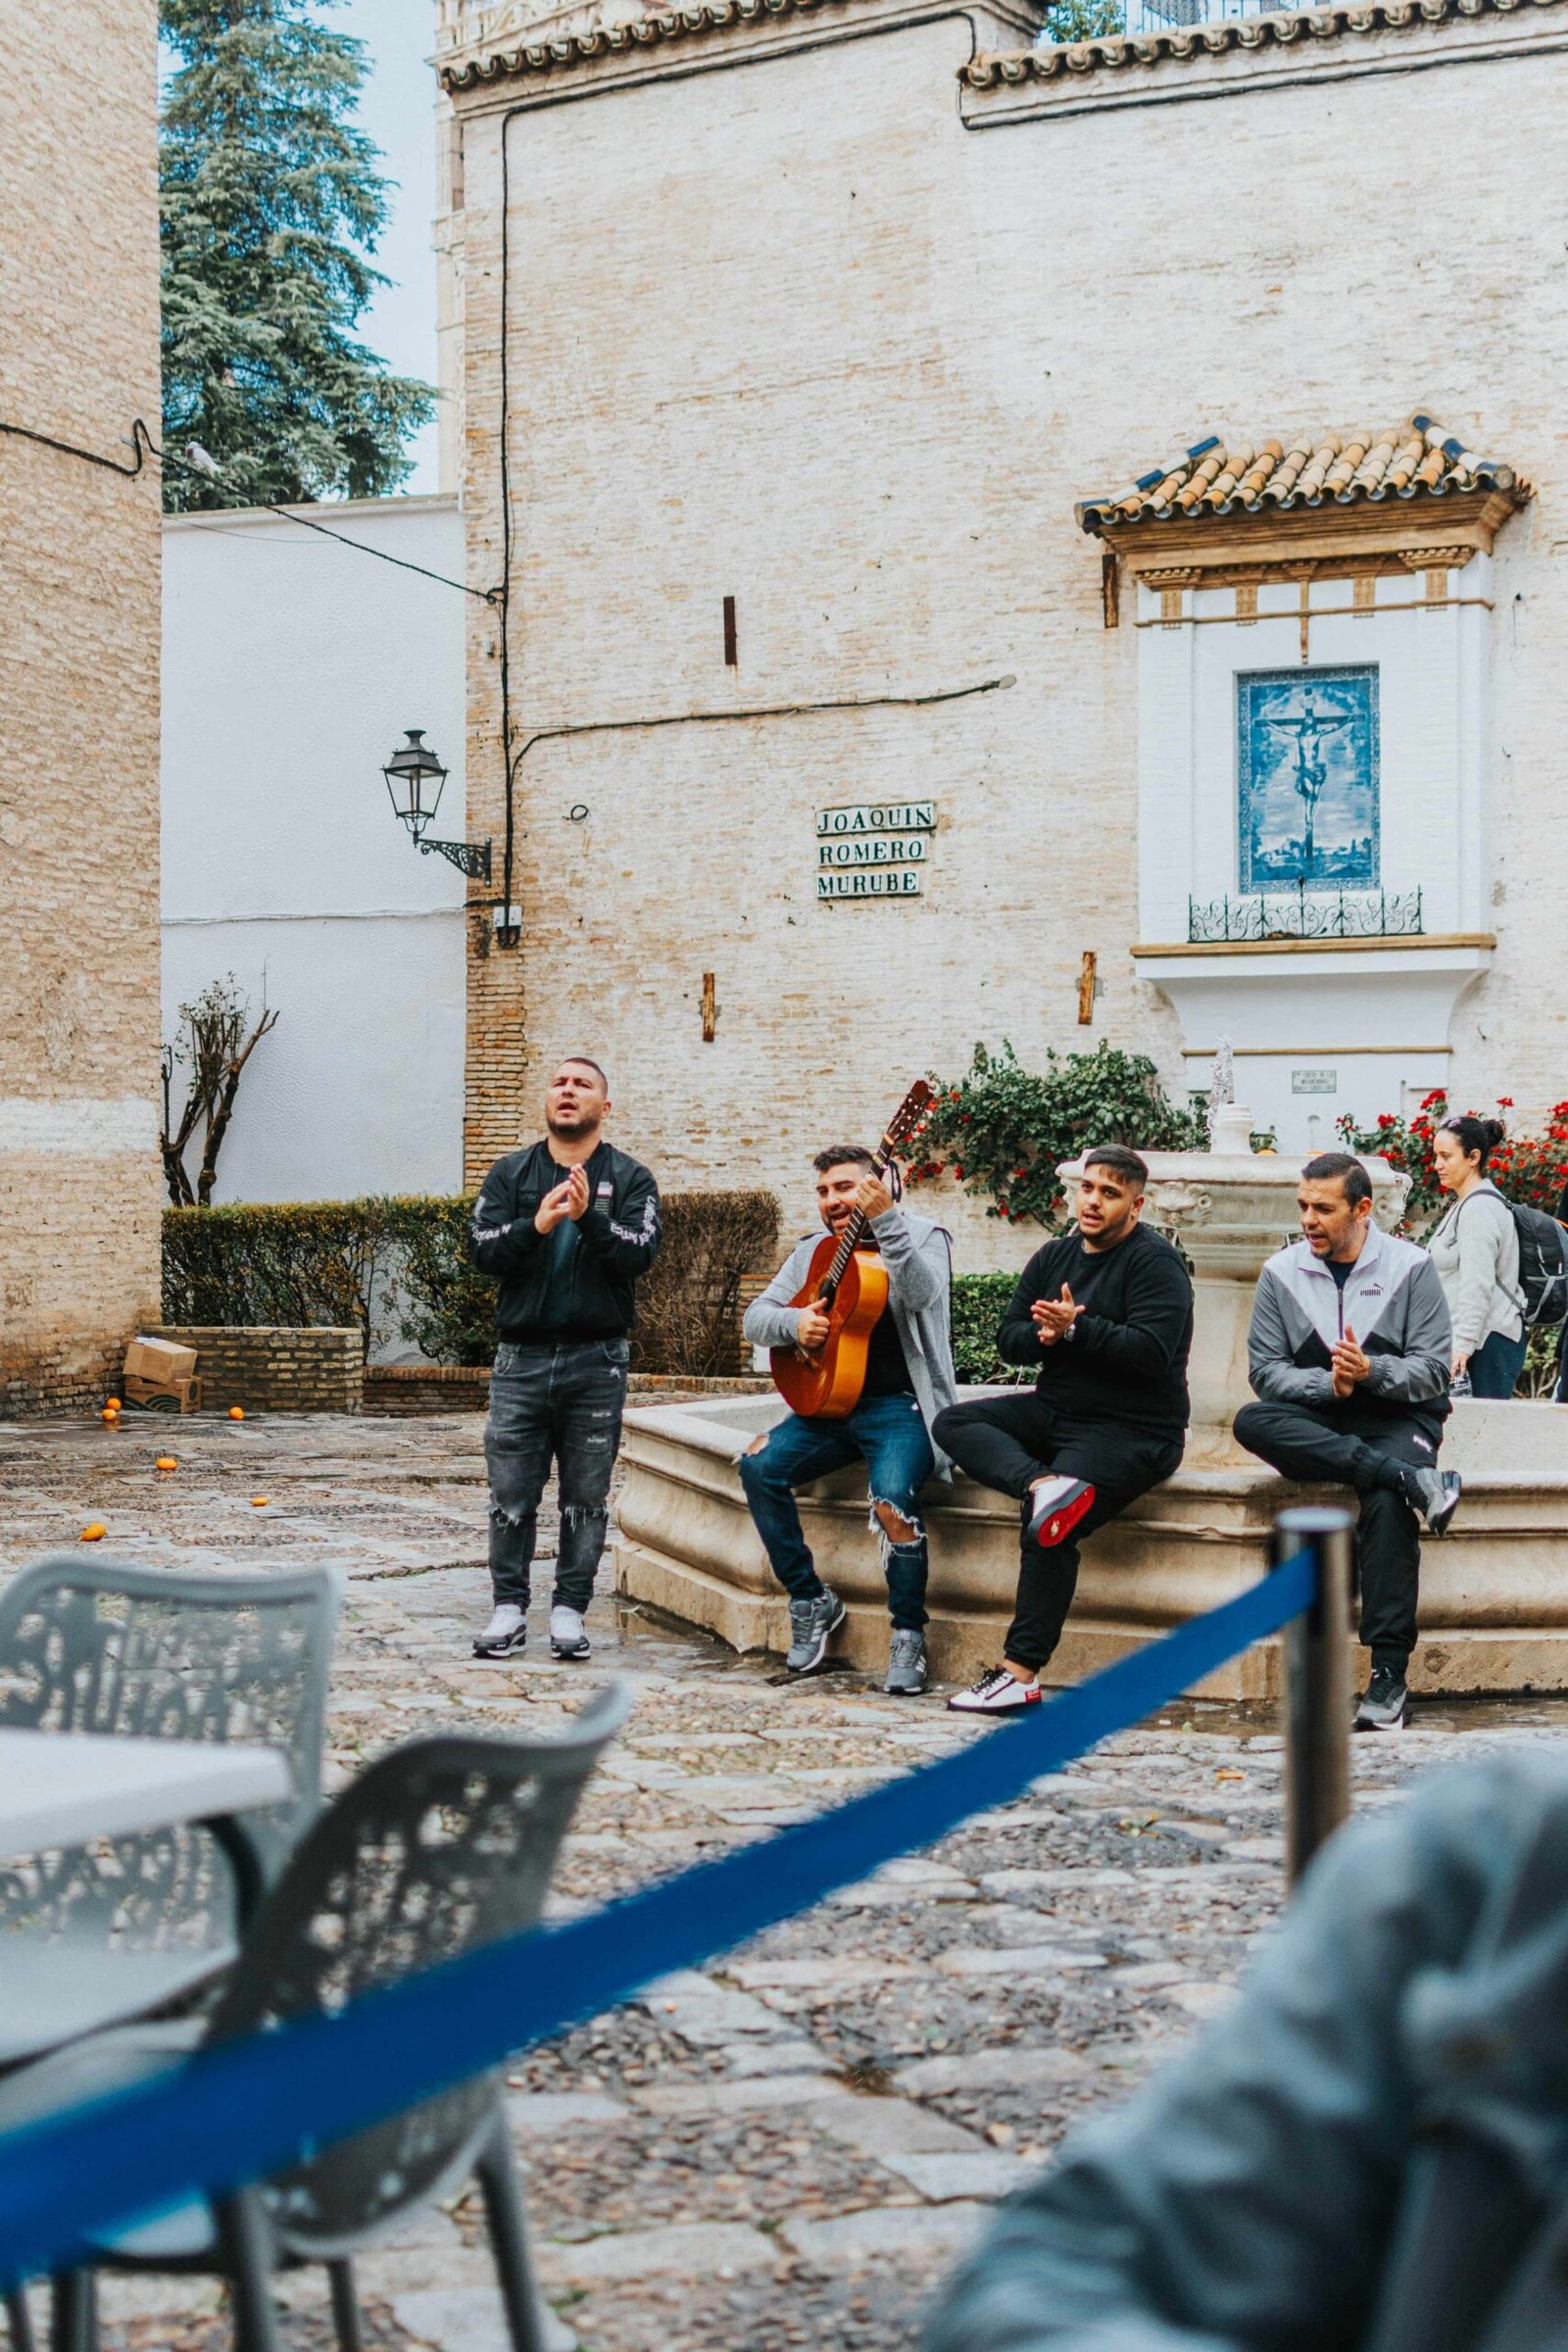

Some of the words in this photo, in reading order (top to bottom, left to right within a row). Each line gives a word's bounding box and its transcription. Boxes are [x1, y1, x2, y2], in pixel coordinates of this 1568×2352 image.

[817, 807, 932, 832] JOAQUIN
[819, 840, 922, 864] ROMERO
[817, 871, 917, 895] MURUBE
